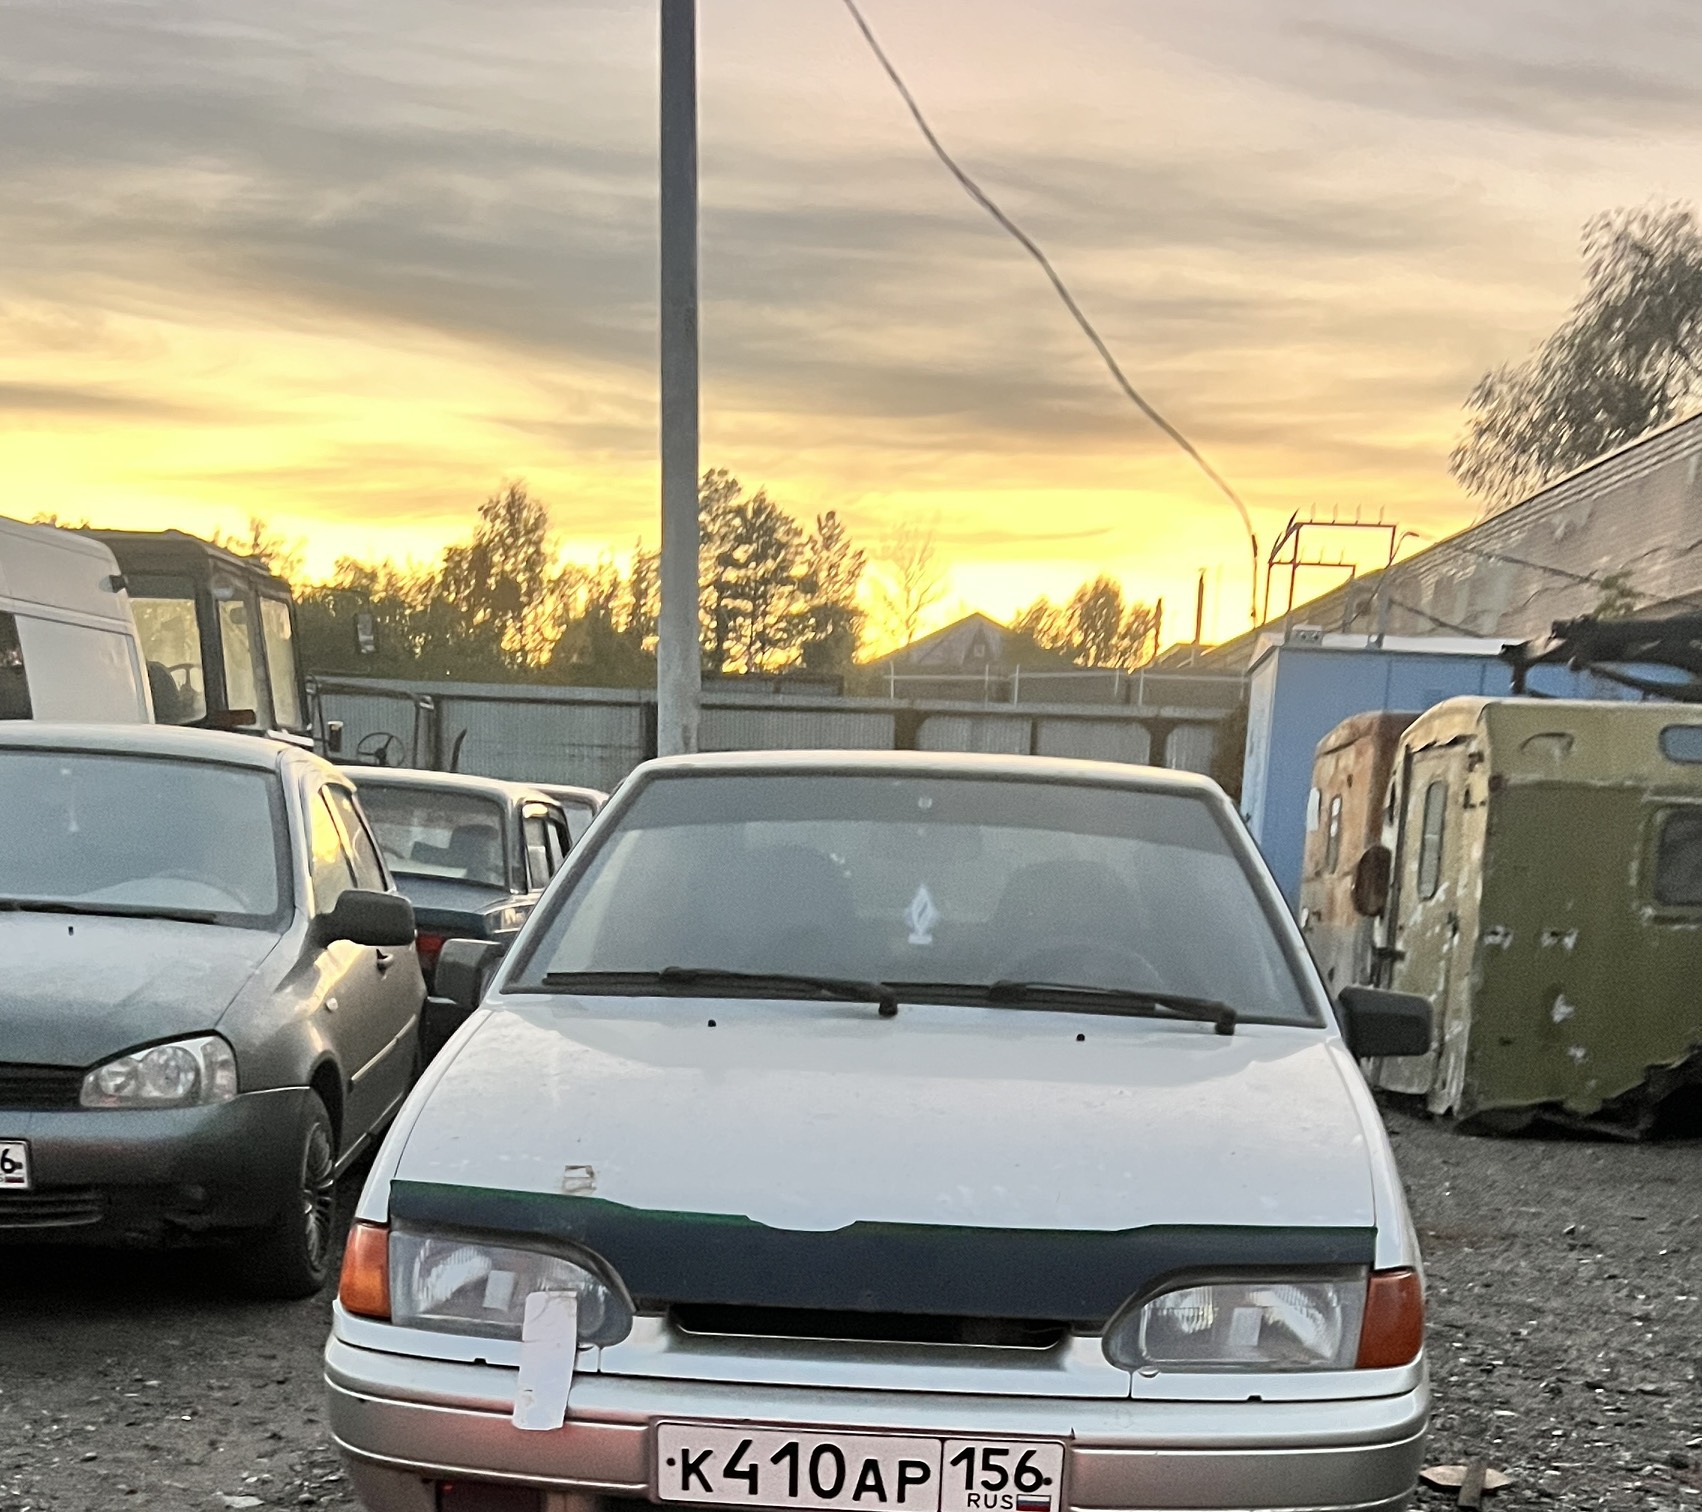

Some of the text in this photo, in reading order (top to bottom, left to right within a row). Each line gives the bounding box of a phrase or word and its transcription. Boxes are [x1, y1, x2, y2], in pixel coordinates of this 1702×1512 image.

[680, 1439, 1044, 1504] К410АР 156
[966, 1492, 1014, 1511] RUS
